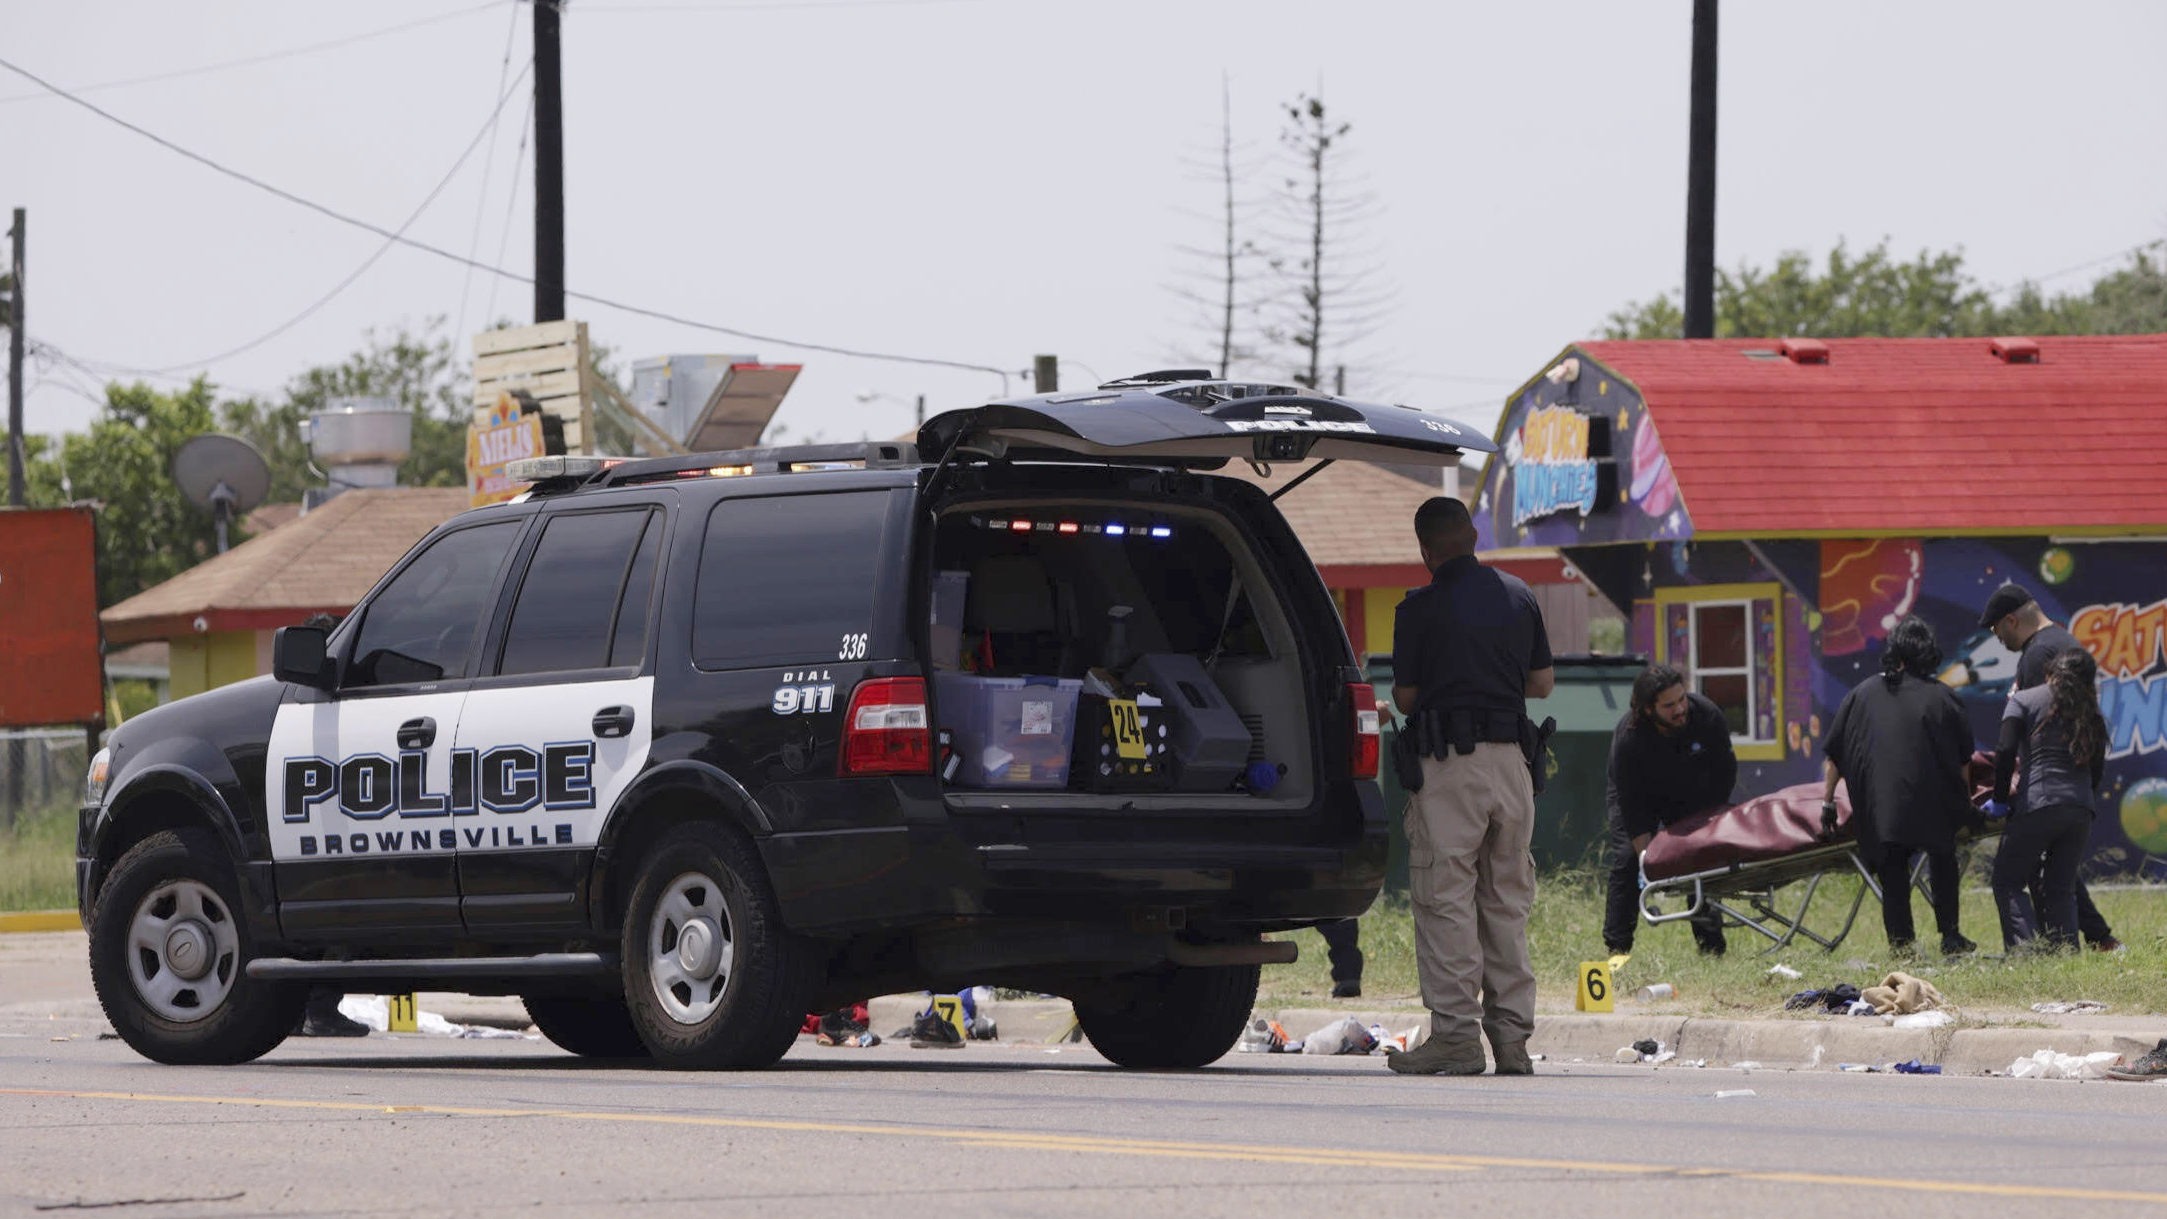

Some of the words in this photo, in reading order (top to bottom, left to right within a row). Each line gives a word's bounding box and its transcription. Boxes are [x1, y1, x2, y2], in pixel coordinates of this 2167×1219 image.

[1226, 420, 1377, 434] POLICE
[1419, 418, 1461, 436] 336
[1522, 402, 1590, 462] SATURN
[839, 633, 868, 660] 336
[2068, 598, 2167, 678] SAT
[782, 670, 831, 682] DIAL
[772, 683, 835, 715] 911
[1114, 705, 1141, 744] 24
[282, 740, 596, 823] POLICE
[300, 824, 573, 855] BROWNSVILLE
[1587, 968, 1605, 1001] 6
[938, 1002, 955, 1022] 7
